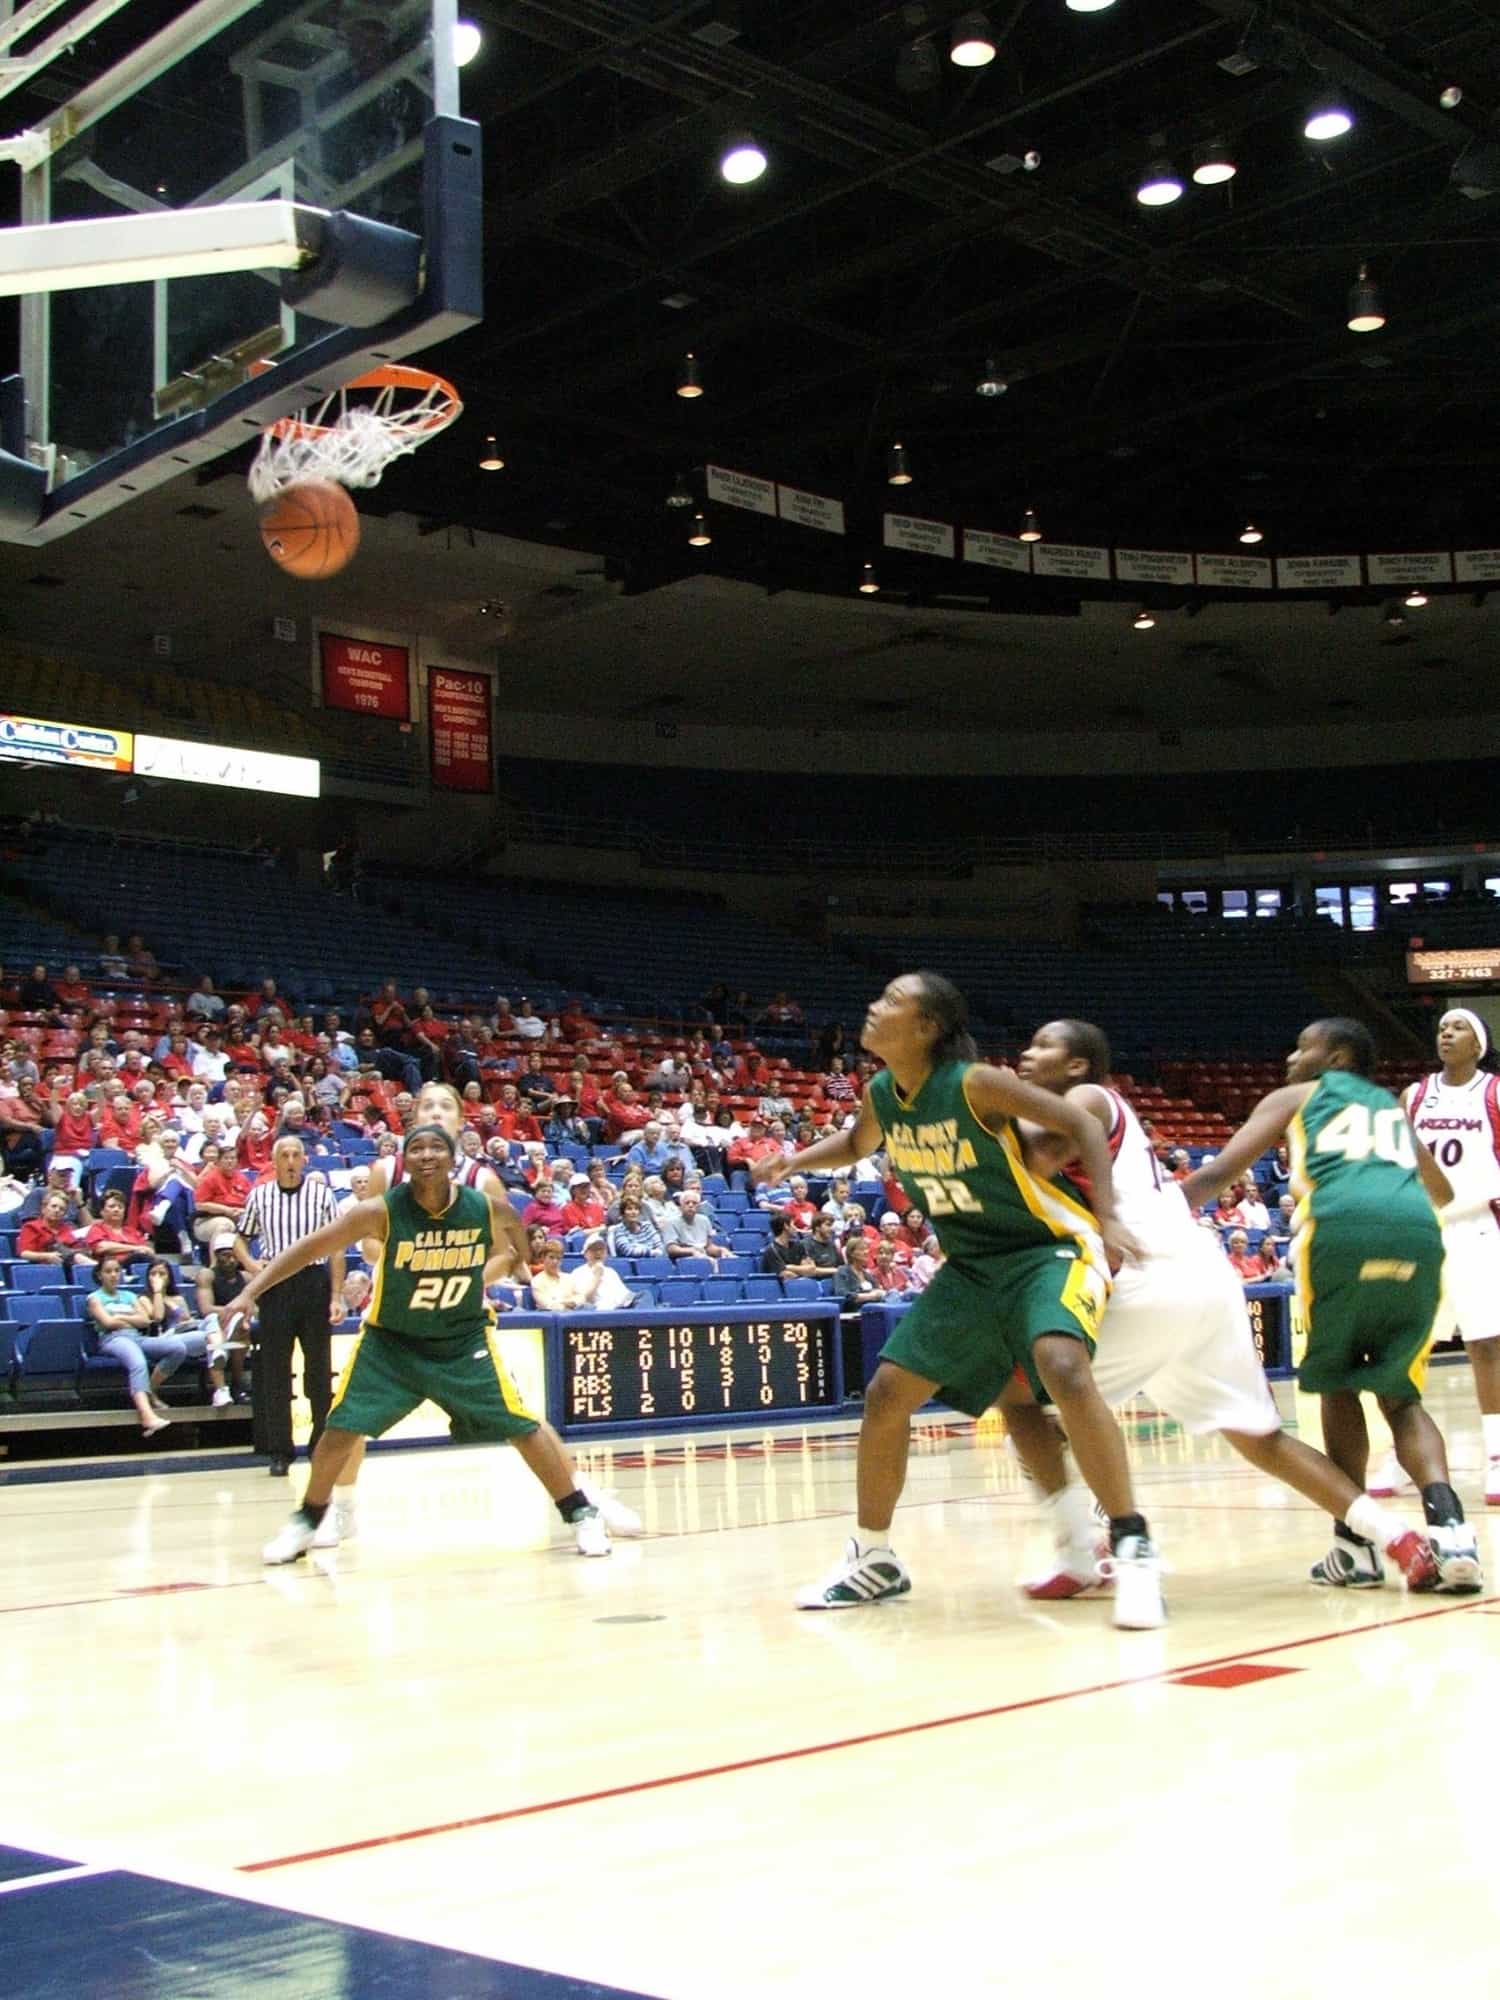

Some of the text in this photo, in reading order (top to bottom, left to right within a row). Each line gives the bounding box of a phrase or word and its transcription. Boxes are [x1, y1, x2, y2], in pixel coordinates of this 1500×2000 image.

[348, 648, 382, 665] WAC
[436, 675, 482, 694] Pac-10
[1315, 1103, 1417, 1169] 40
[416, 1230, 443, 1248] CAL
[395, 1241, 485, 1271] POMONA
[409, 1275, 472, 1310] 20
[639, 1329, 652, 1349] 2
[669, 1328, 692, 1347] 10
[709, 1326, 732, 1346] 14
[748, 1324, 770, 1344] 15
[783, 1323, 807, 1342] 20
[575, 1353, 608, 1373] PTS
[639, 1351, 653, 1370] 0
[670, 1349, 693, 1368] 10
[720, 1346, 733, 1366] 8
[796, 1343, 808, 1361] 7
[574, 1374, 612, 1396] RBS
[681, 1369, 694, 1389] 5
[720, 1367, 734, 1387] 3
[797, 1363, 809, 1381] 3
[574, 1396, 612, 1416] FLS
[640, 1393, 655, 1413] 2
[682, 1391, 695, 1410] 0
[760, 1386, 773, 1404] 0
